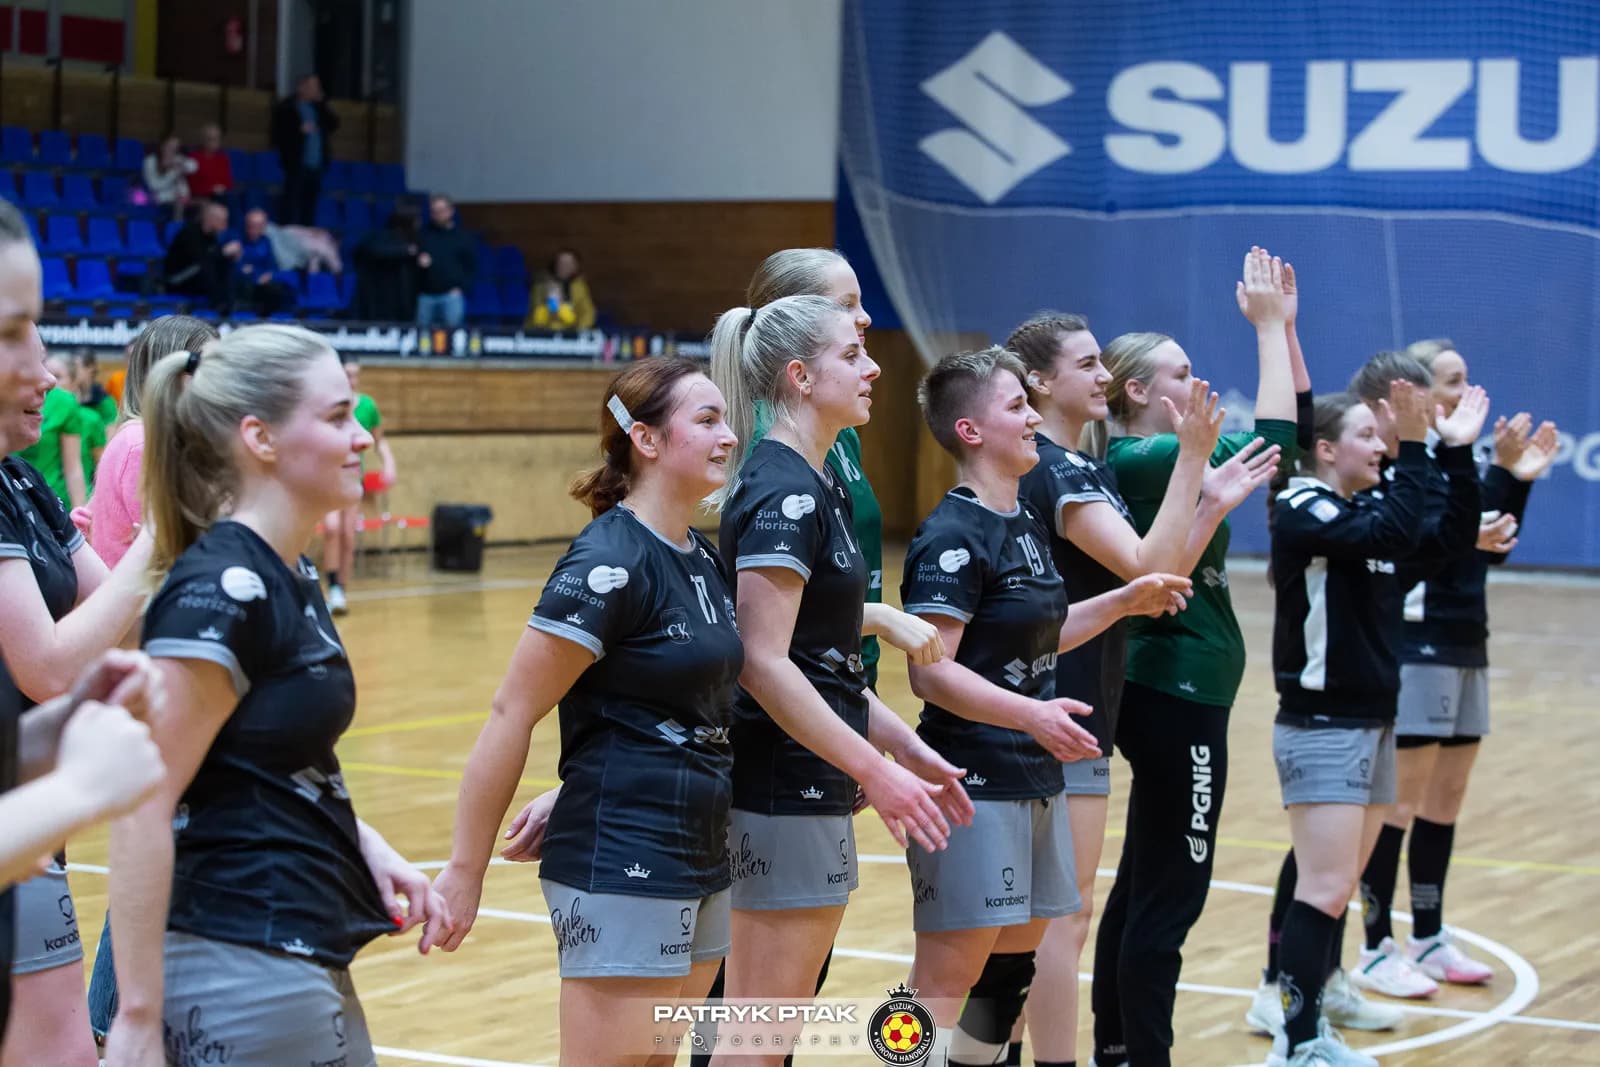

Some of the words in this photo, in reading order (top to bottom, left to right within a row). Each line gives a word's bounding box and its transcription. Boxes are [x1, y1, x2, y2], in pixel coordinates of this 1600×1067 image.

[1104, 57, 1599, 175] SUZU
[756, 510, 778, 519] Sun
[1016, 532, 1045, 577] 19
[918, 562, 936, 572] Sun
[560, 572, 582, 586] Sun
[917, 572, 959, 585] Horizon
[553, 583, 606, 610] Horizon
[667, 621, 689, 641] CK
[1189, 745, 1213, 832] PGNiG
